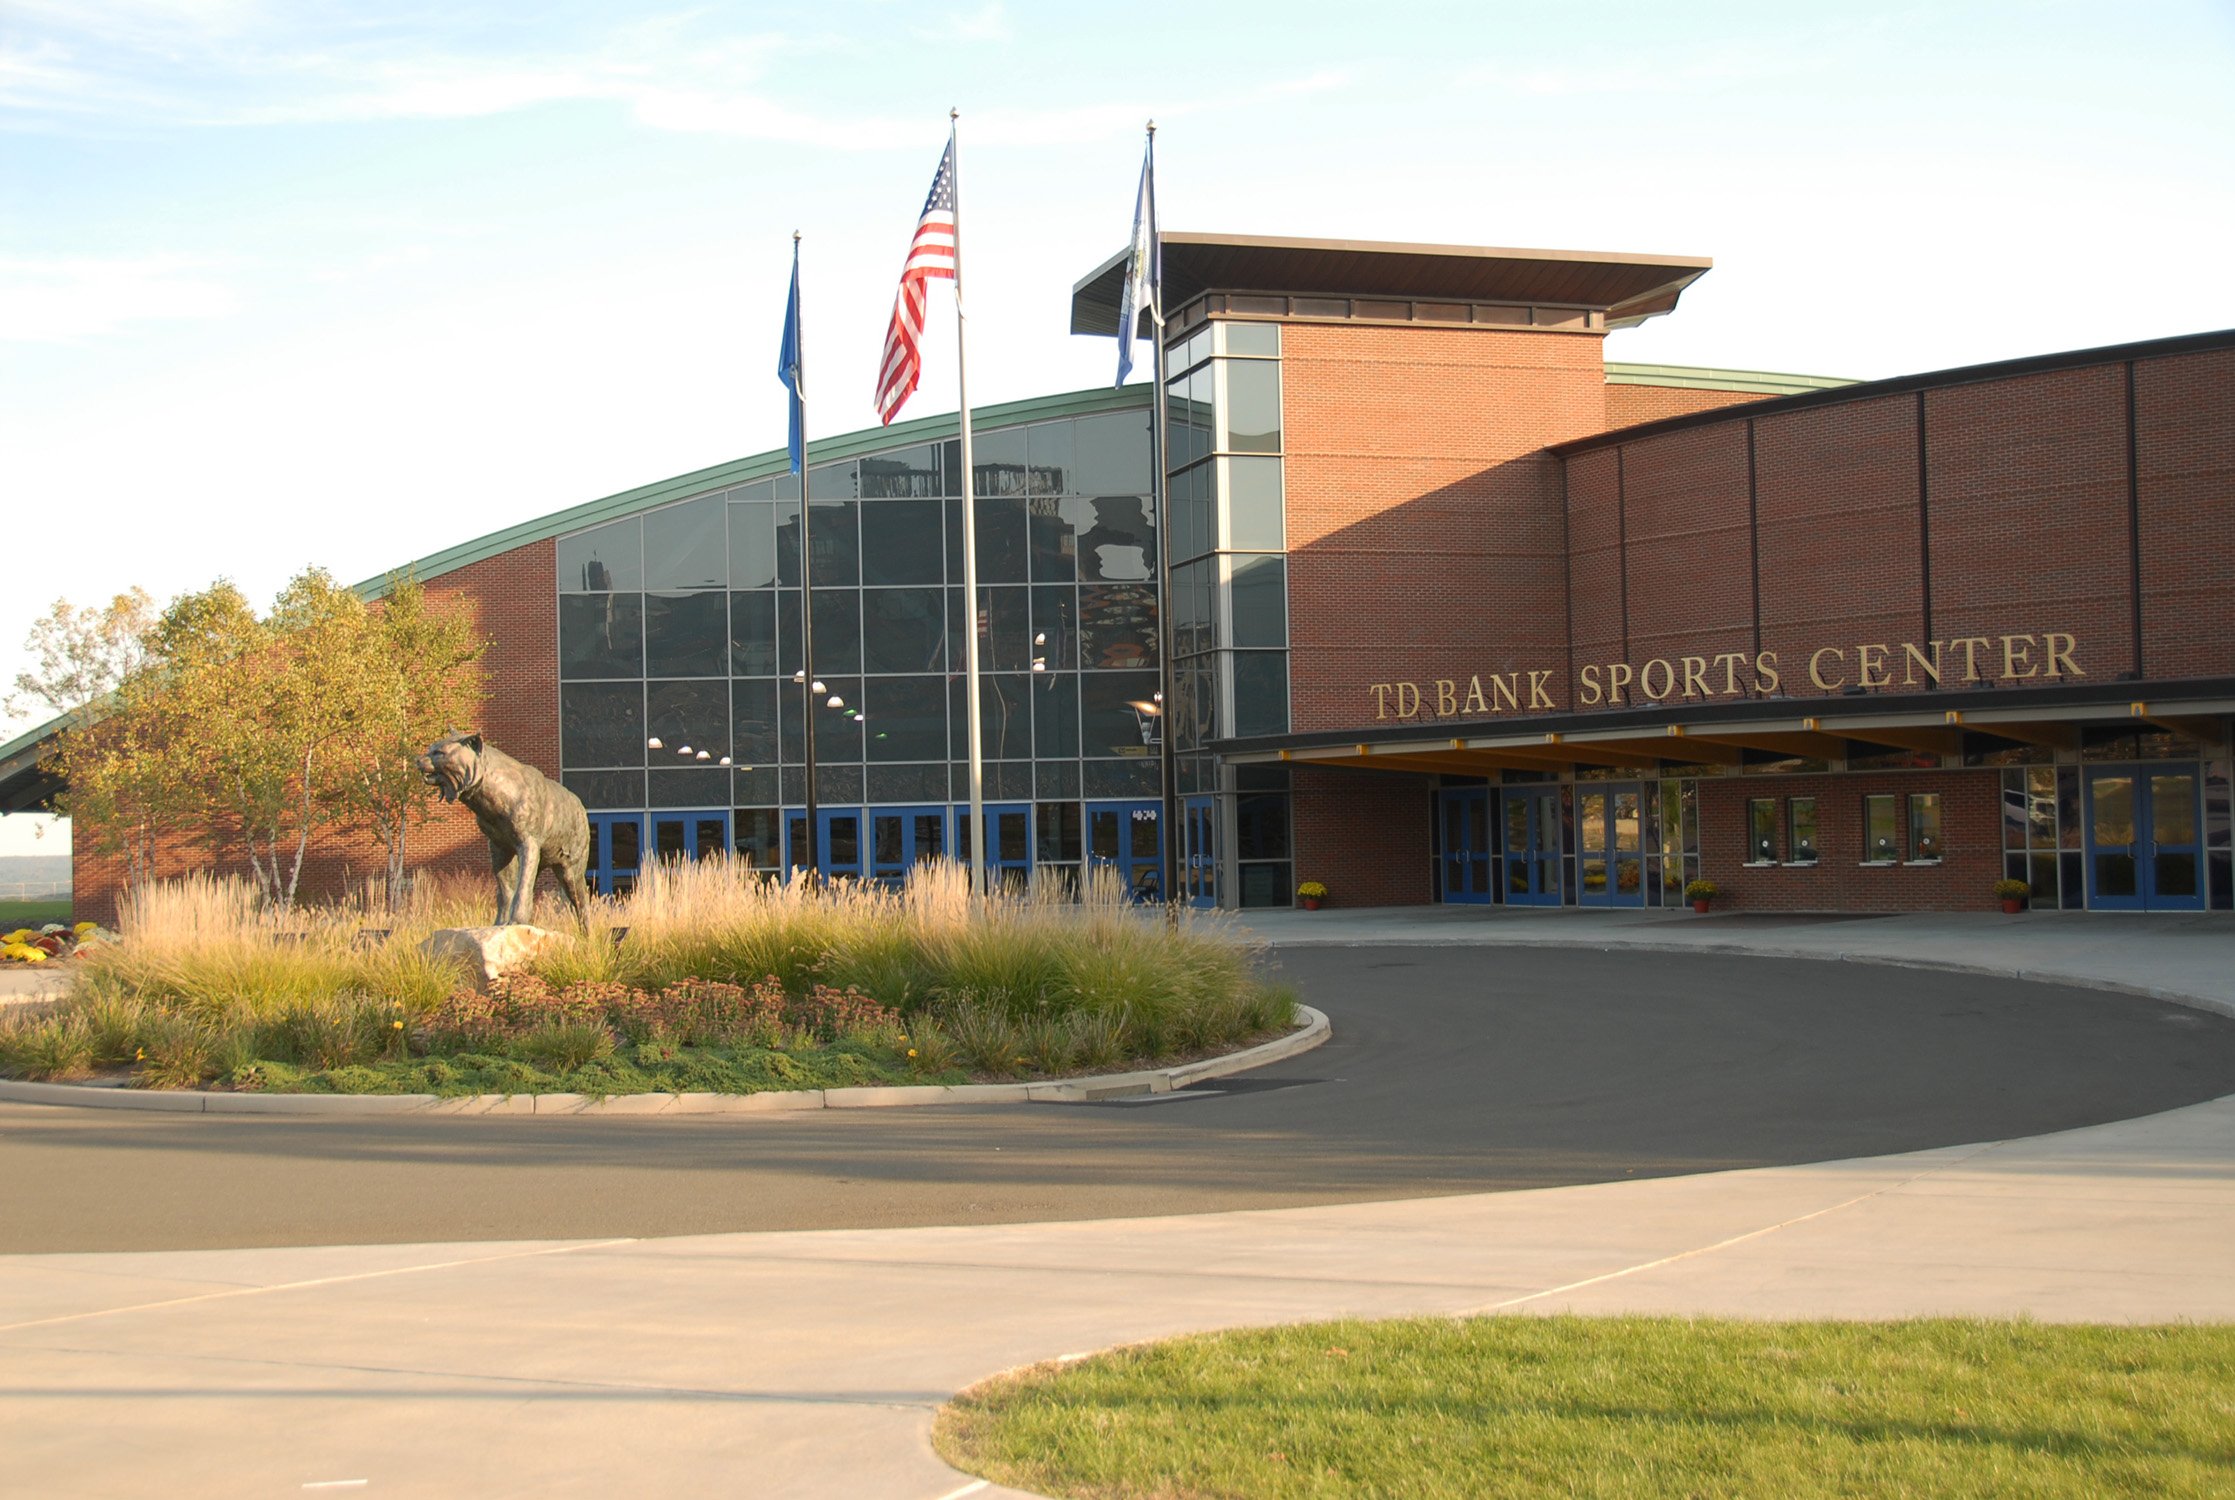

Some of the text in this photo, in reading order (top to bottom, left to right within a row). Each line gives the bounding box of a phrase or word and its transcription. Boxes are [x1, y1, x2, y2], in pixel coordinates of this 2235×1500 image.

[1369, 633, 2087, 719] TD BANK SPORTS CENTER
